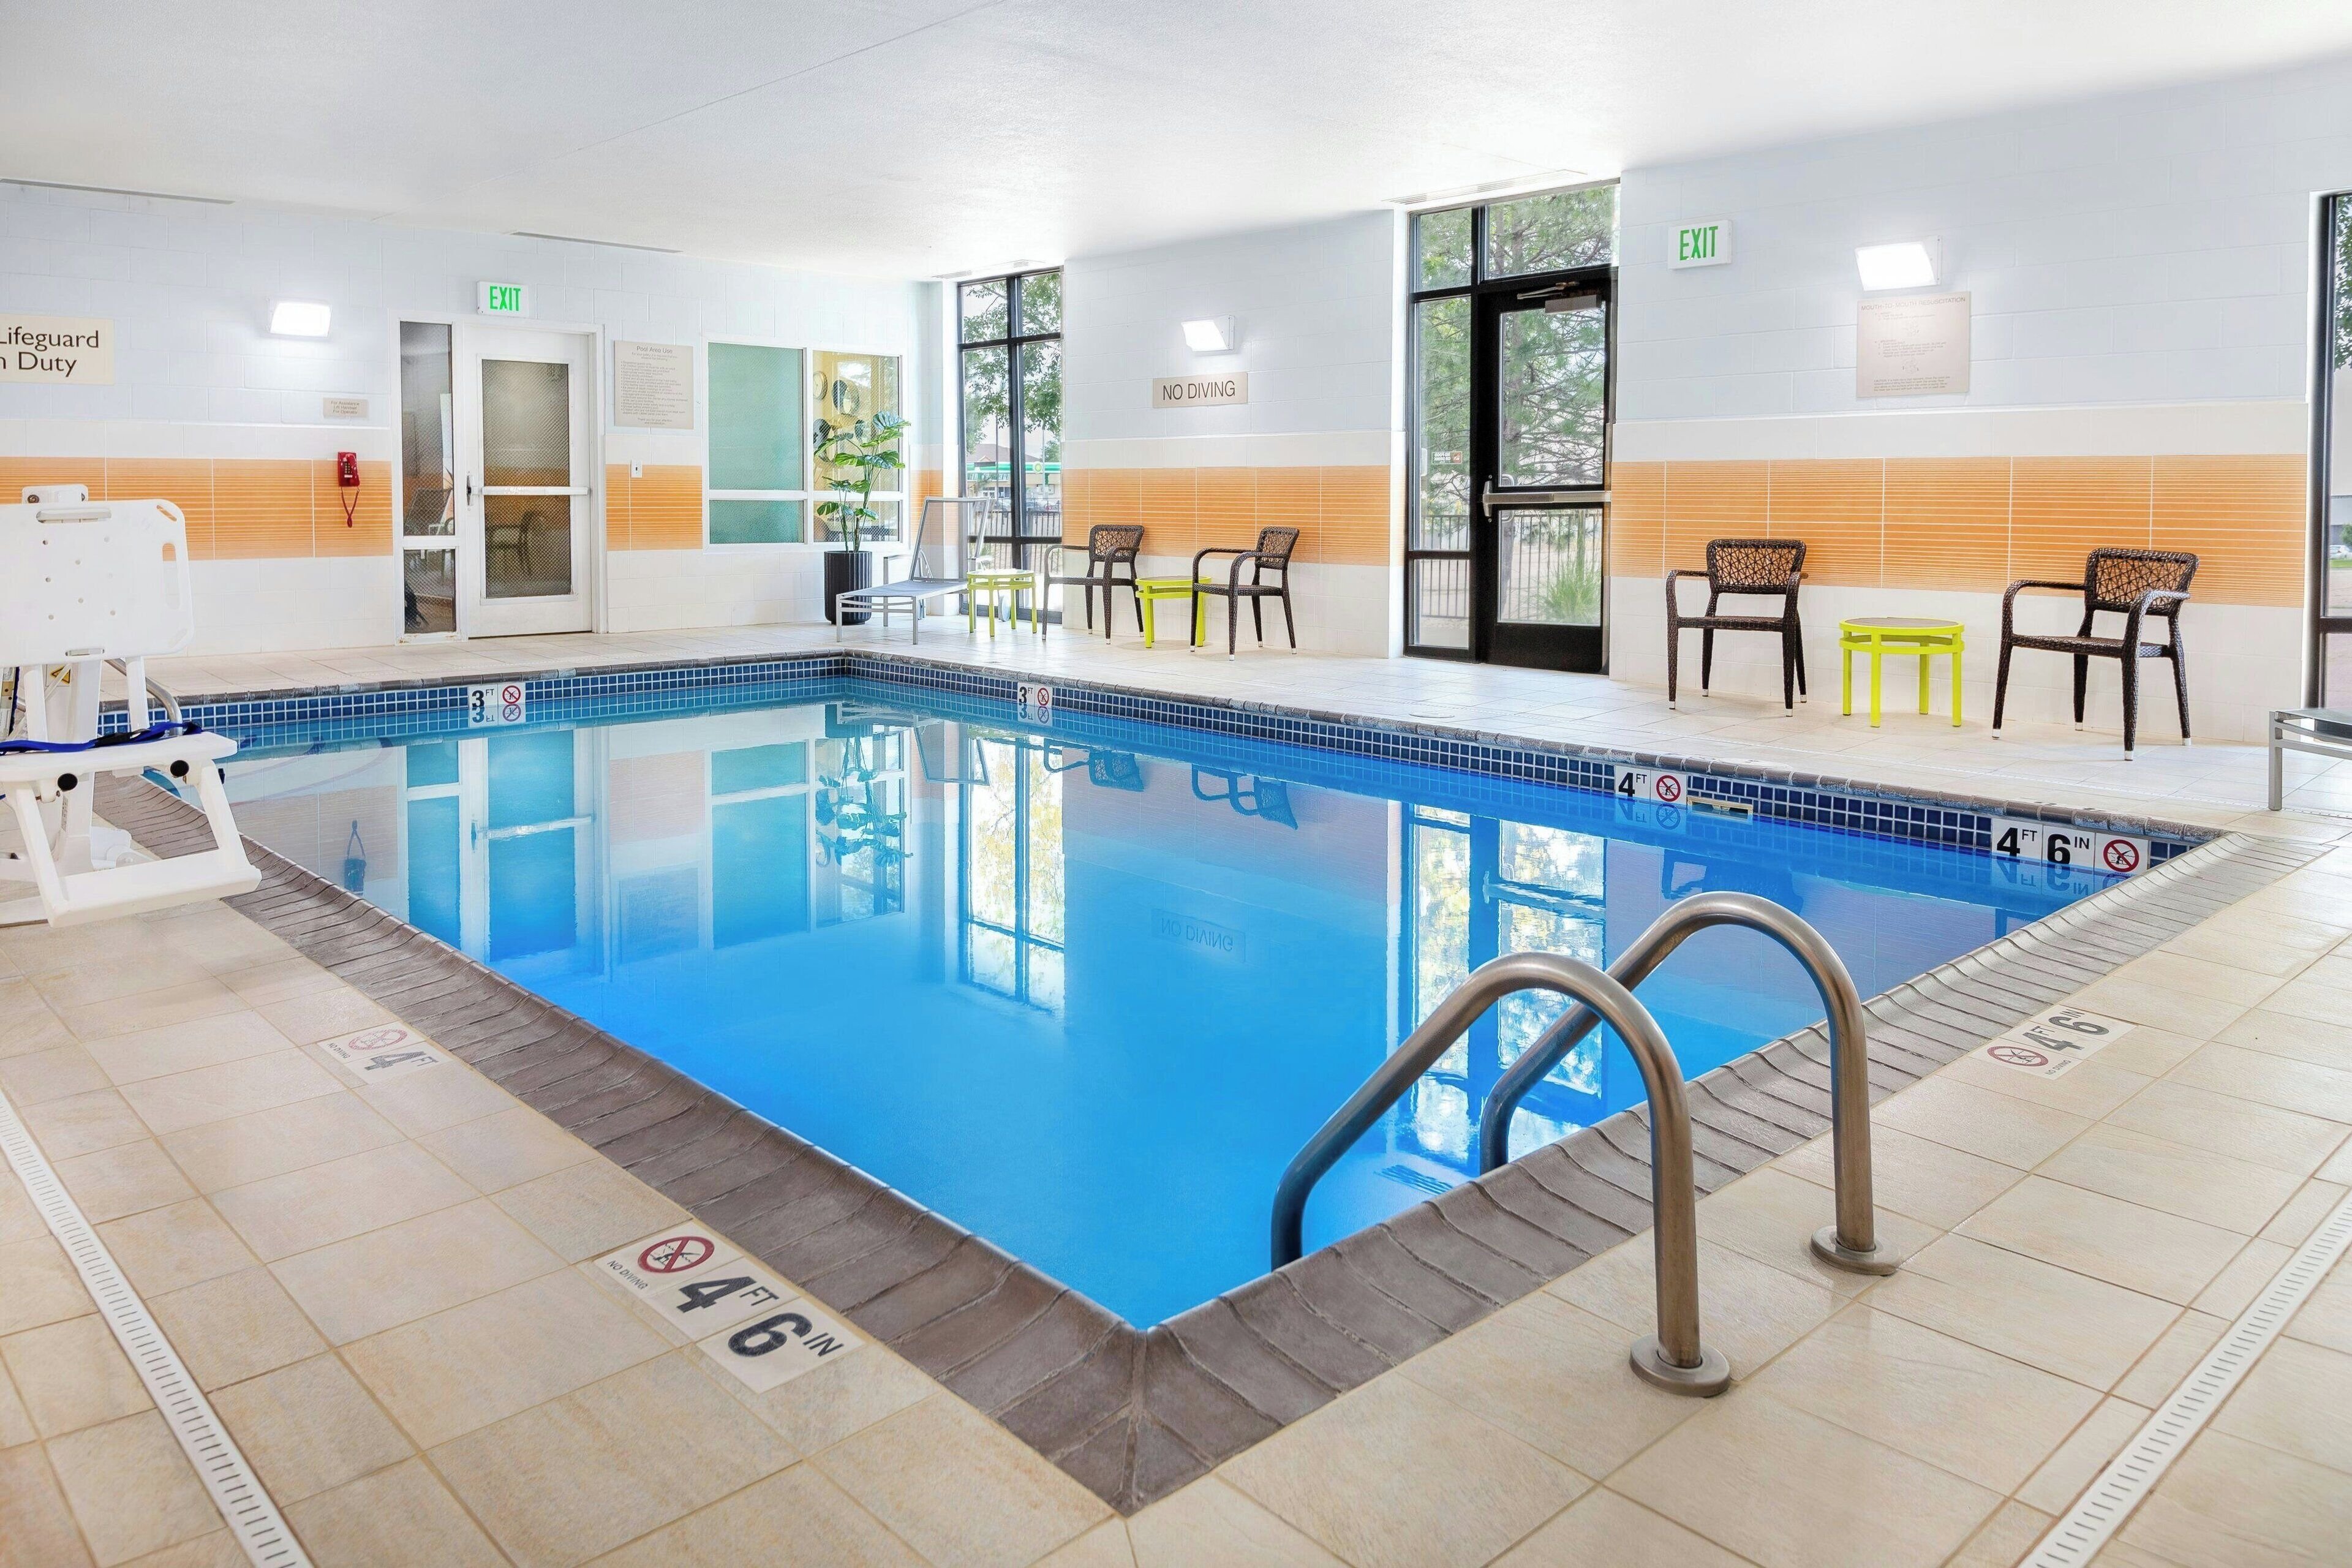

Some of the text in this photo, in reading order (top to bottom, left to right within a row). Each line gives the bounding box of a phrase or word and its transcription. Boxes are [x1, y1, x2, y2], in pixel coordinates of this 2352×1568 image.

[1679, 225, 1719, 260] EXIT
[489, 285, 521, 312] EXIT
[18, 351, 77, 377] Duty
[1163, 380, 1235, 401] NO DIVING
[472, 690, 485, 707] 3
[1019, 686, 1027, 704] 3
[1618, 772, 1648, 797] 4 FT
[1996, 827, 2090, 864] 4 FT 6 IN
[2048, 1008, 2110, 1036] 6 IN
[2022, 1025, 2085, 1051] 4 FT
[364, 1050, 439, 1071] 4 FT
[2045, 1059, 2071, 1076] NO DIVING
[606, 1260, 648, 1291] NO DIVING
[676, 1275, 780, 1313] 4 FT
[728, 1312, 845, 1357] 6 IN
